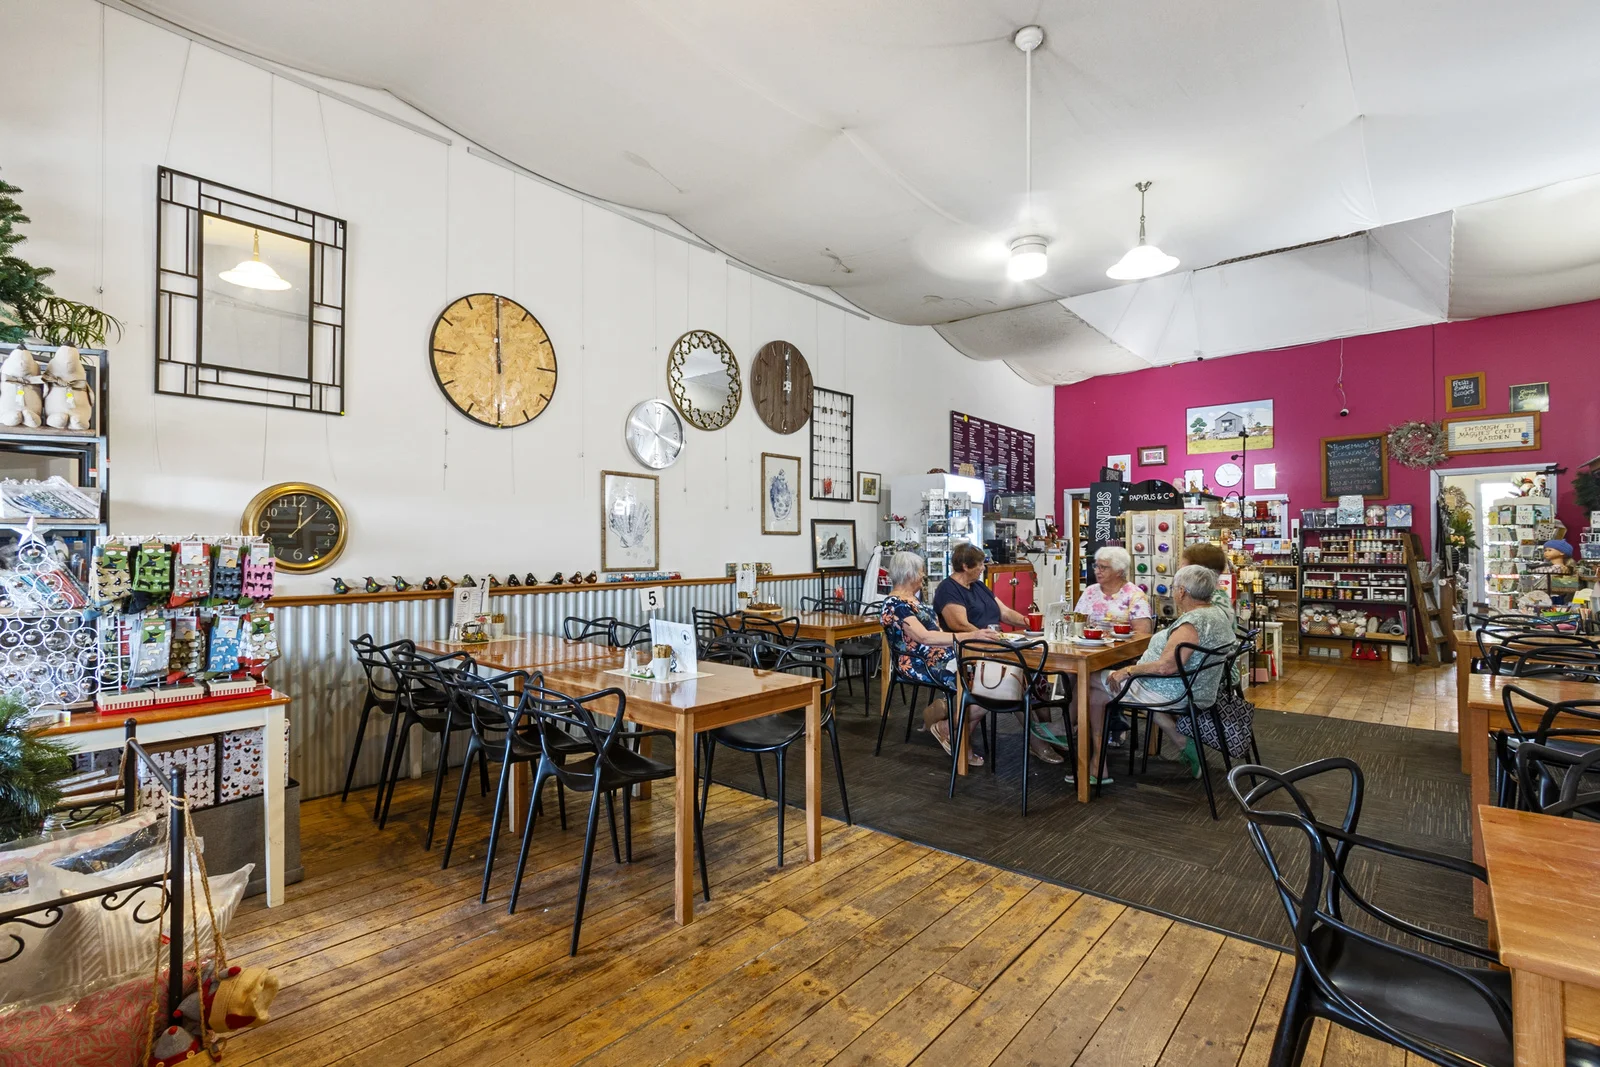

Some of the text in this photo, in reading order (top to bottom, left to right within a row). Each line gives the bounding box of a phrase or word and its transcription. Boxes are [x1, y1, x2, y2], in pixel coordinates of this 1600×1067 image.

[1494, 427, 1523, 435] COFFEE
[1477, 434, 1510, 442] GARDEN
[1333, 441, 1369, 451] HOMEMADE
[291, 495, 308, 508] 12
[1129, 493, 1156, 501] PAPYRUS
[1156, 492, 1162, 500] &
[278, 498, 288, 508] 11
[315, 501, 320, 510] 1
[266, 507, 278, 517] 10
[324, 510, 332, 519] 2
[260, 520, 271, 533] 9
[327, 523, 336, 536] 3
[323, 539, 330, 547] 4
[277, 546, 285, 556] 7
[292, 547, 303, 560] 6
[313, 547, 319, 556] 5
[480, 578, 486, 590] 7
[648, 590, 657, 606] 5
